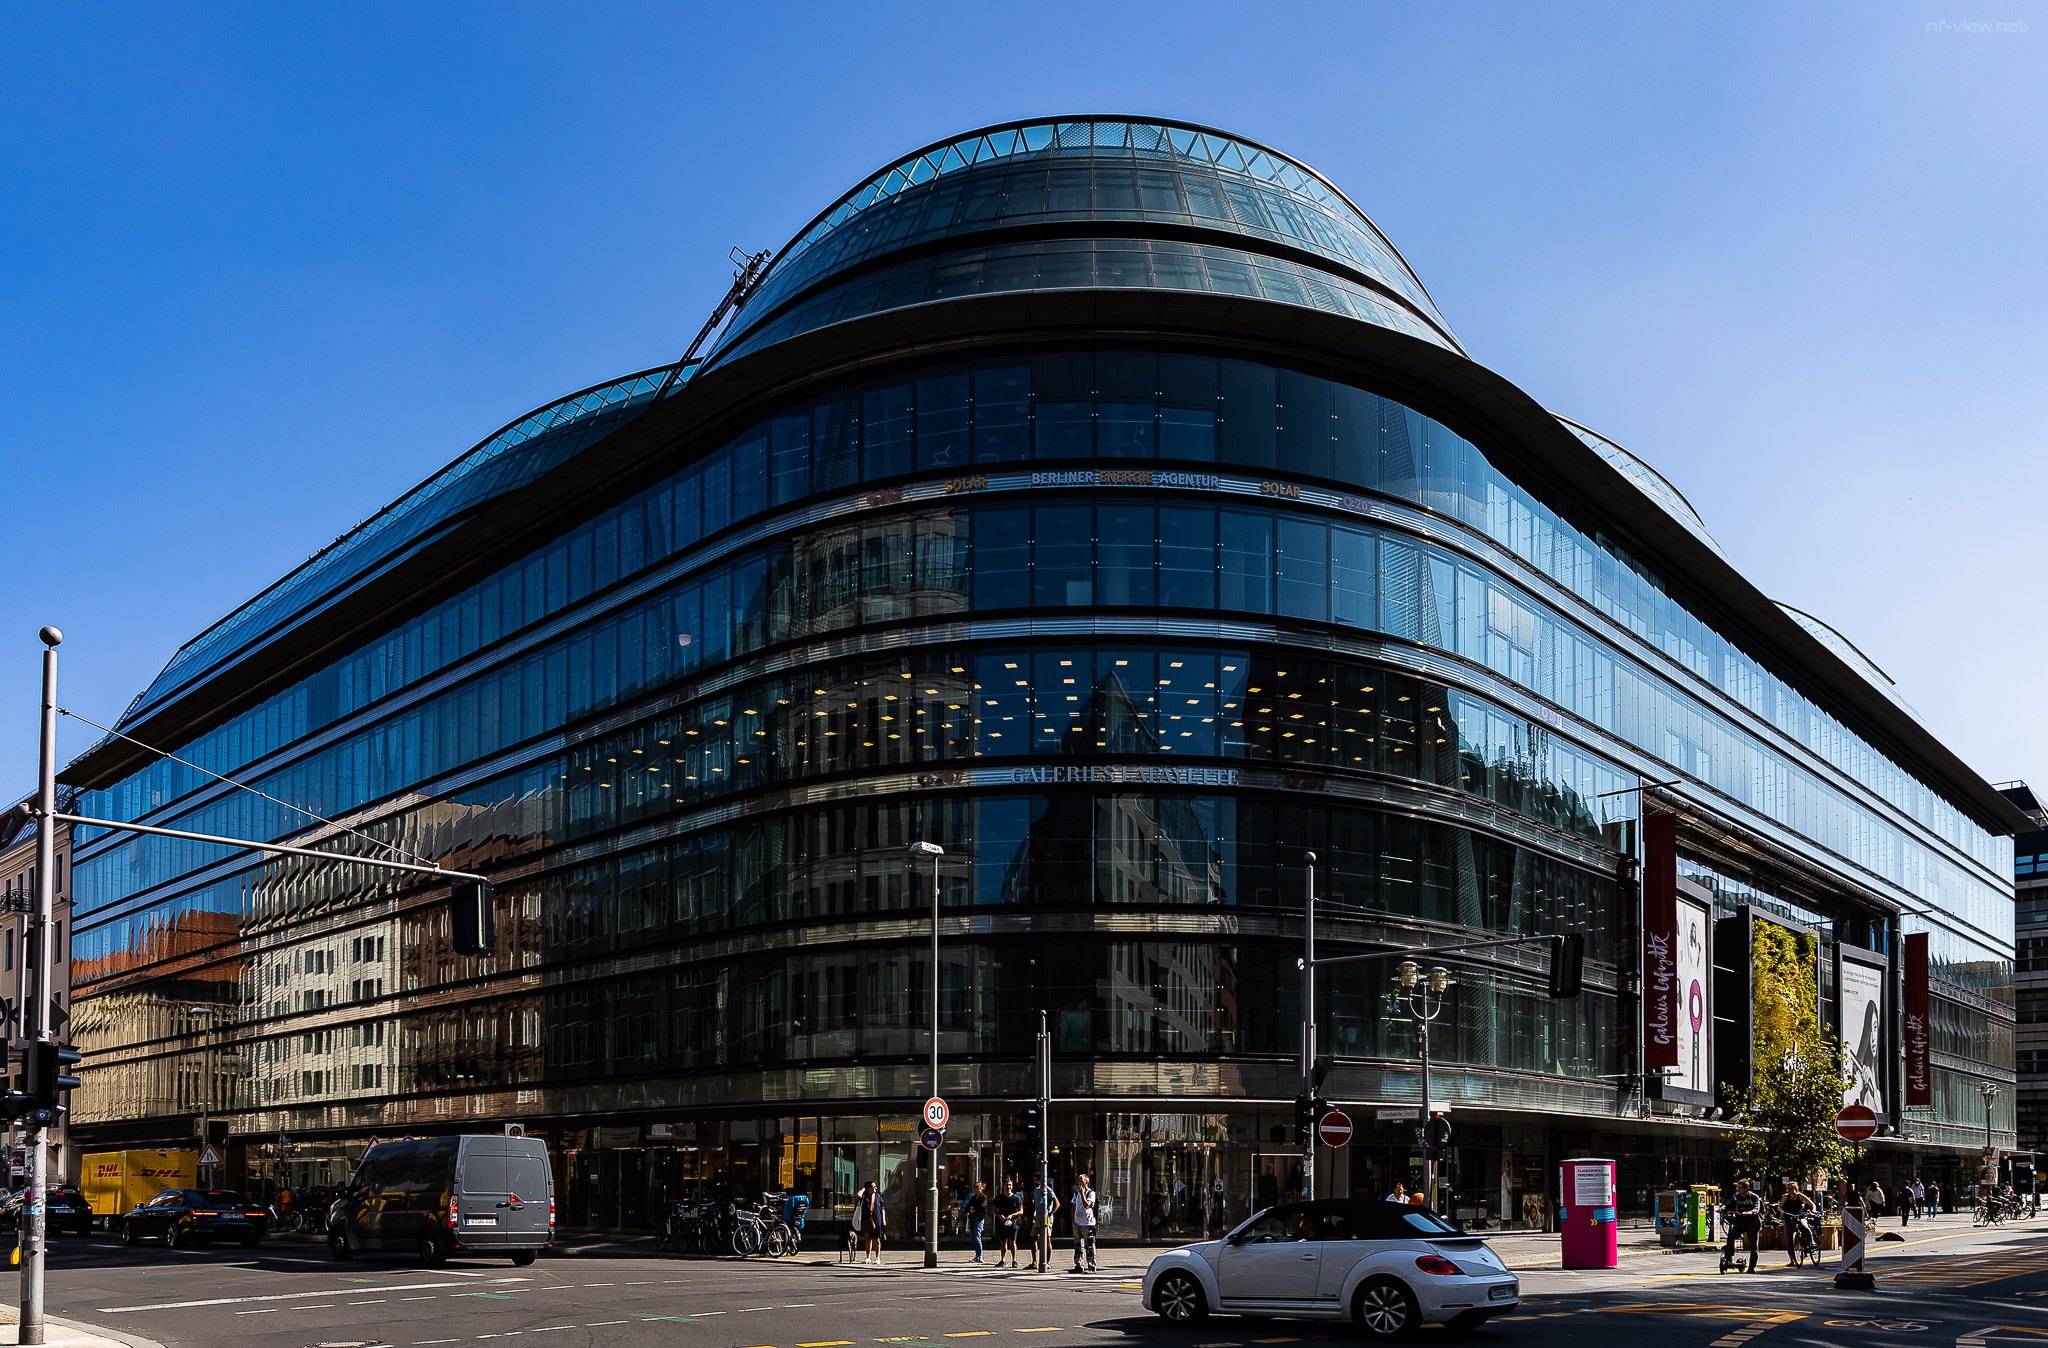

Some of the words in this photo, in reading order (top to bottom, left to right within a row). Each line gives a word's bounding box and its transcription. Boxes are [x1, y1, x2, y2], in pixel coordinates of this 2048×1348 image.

[945, 476, 987, 492] SOLAR
[1031, 471, 1094, 485] BERLINER
[1099, 471, 1154, 484] ENERGIE
[1160, 472, 1219, 488] AGENTUR
[1261, 481, 1300, 499] SOLAR
[1343, 495, 1353, 510] Q
[1355, 498, 1374, 512] 207
[1010, 765, 1115, 784] GALERIES
[1121, 765, 1239, 786] LAFAYETTE
[1647, 930, 1675, 991] Lafayette
[1648, 994, 1675, 1045] Galeries
[1908, 1056, 1928, 1091] Galeries
[930, 1106, 943, 1119] 30
[97, 1164, 119, 1178] DHL
[140, 1169, 183, 1178] DHL
